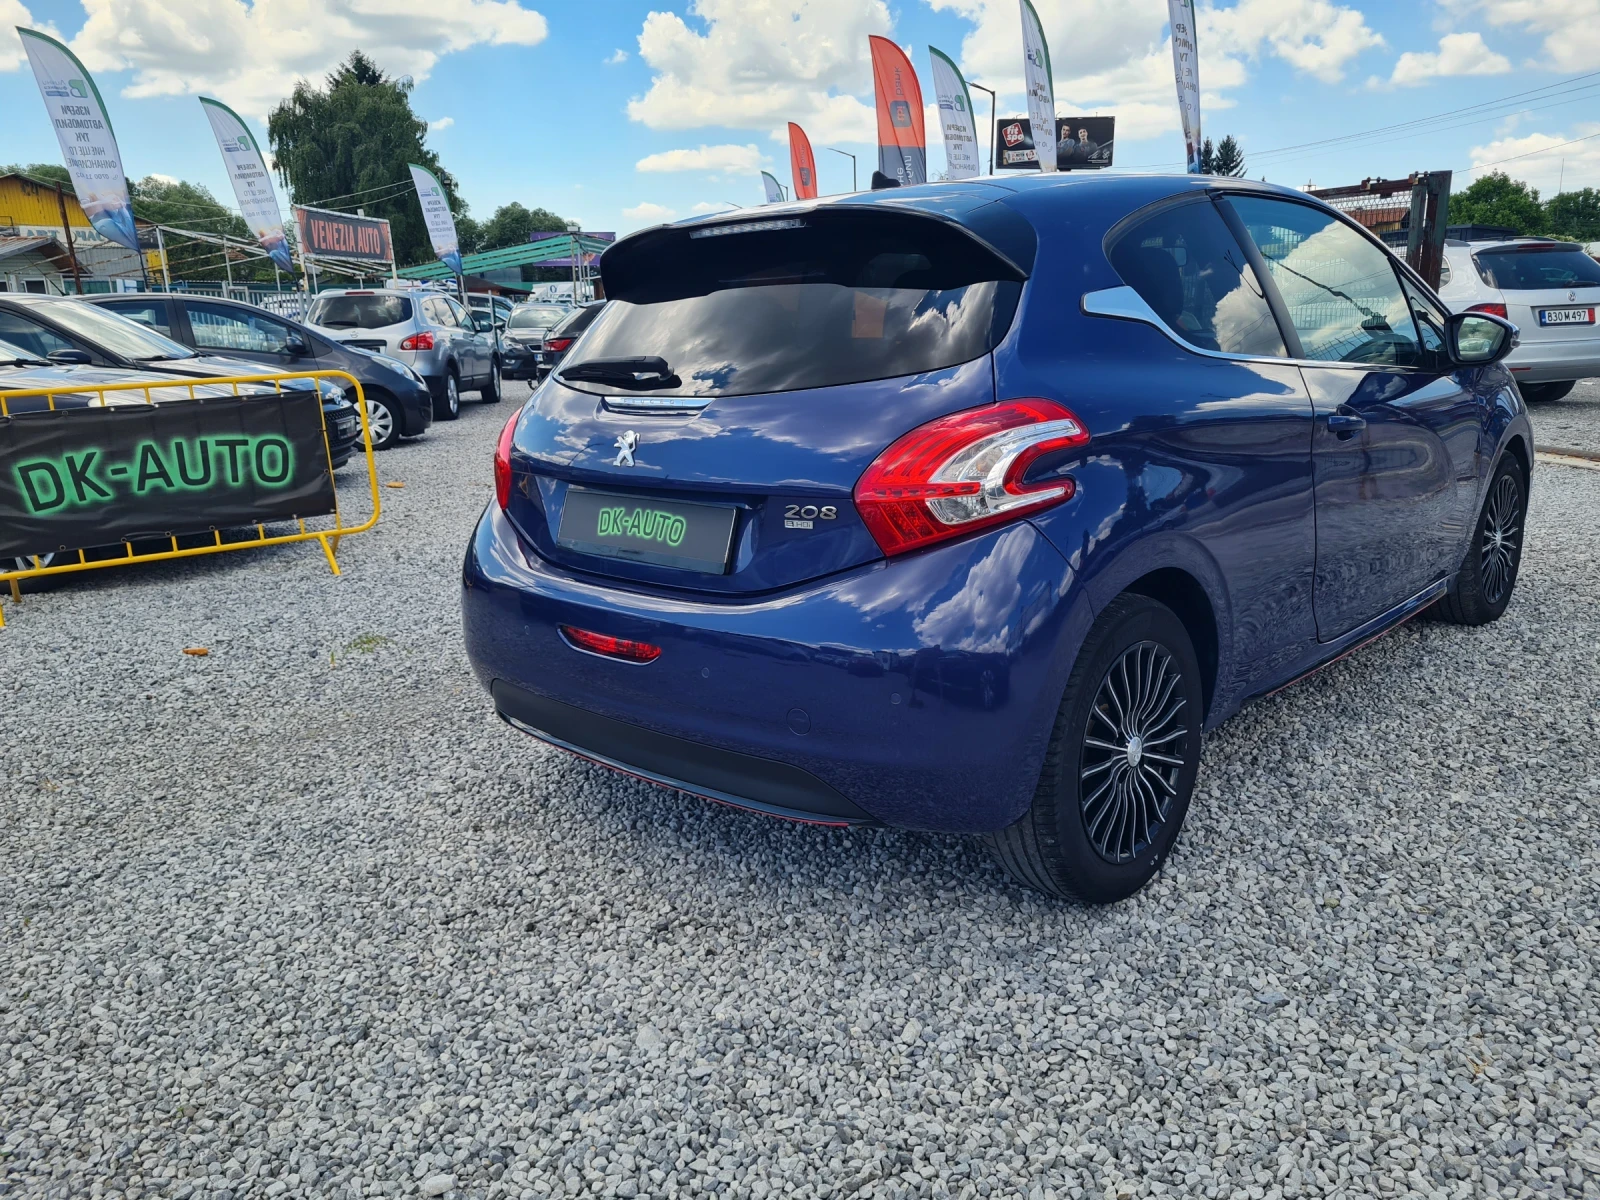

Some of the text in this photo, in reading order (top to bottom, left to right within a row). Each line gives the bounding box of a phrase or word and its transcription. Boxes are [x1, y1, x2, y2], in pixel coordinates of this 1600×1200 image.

[310, 219, 381, 254] VENEZIA AUTO
[16, 437, 291, 513] DK-AUTO
[599, 508, 685, 545] DK-AUTO
[784, 504, 838, 520] 208
